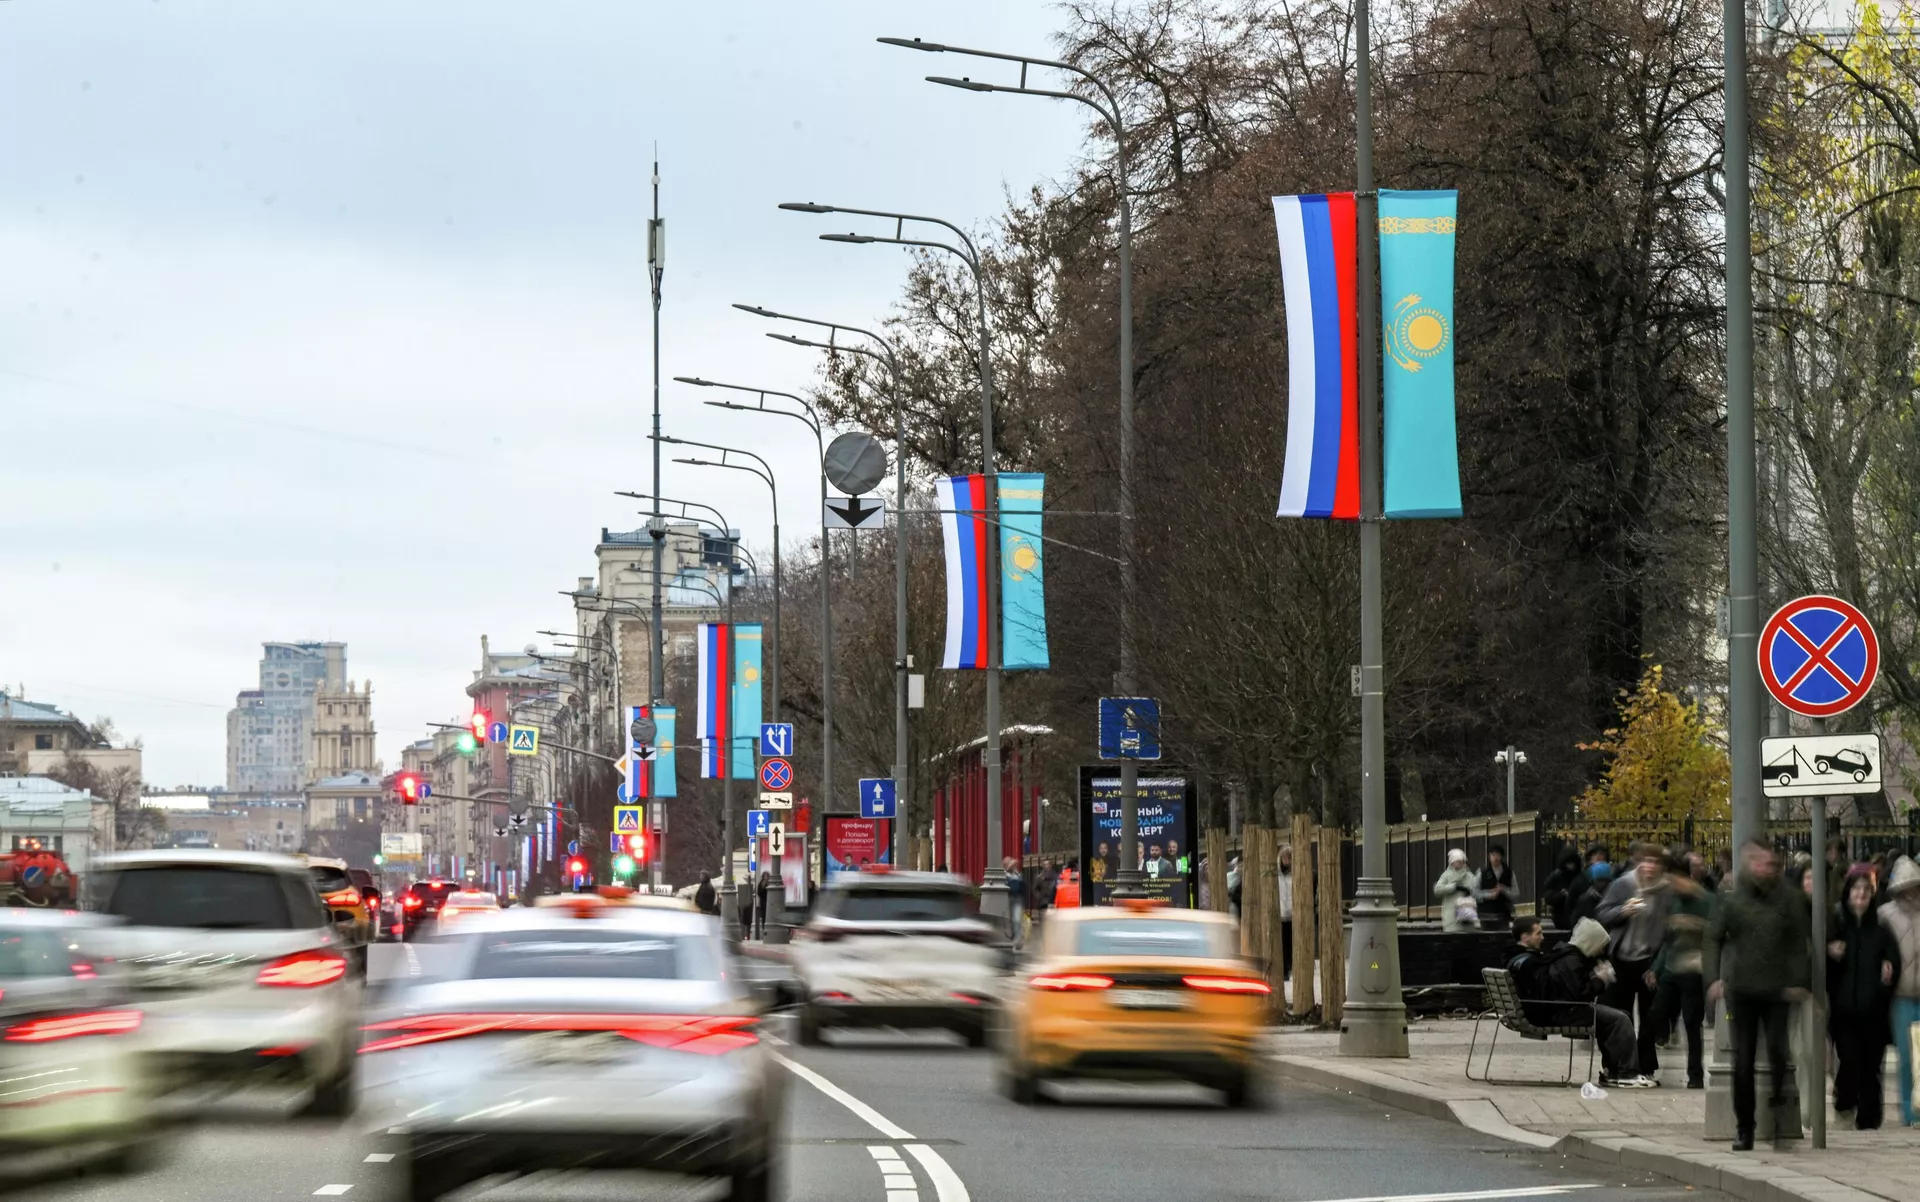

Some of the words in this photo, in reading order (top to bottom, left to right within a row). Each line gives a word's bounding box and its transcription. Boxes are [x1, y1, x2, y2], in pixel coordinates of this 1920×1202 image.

[1105, 790, 1148, 798] ДЕКРЯ
[1109, 805, 1163, 818] ГЛНЫЙ
[1099, 813, 1174, 828] НОВОДНИЙ
